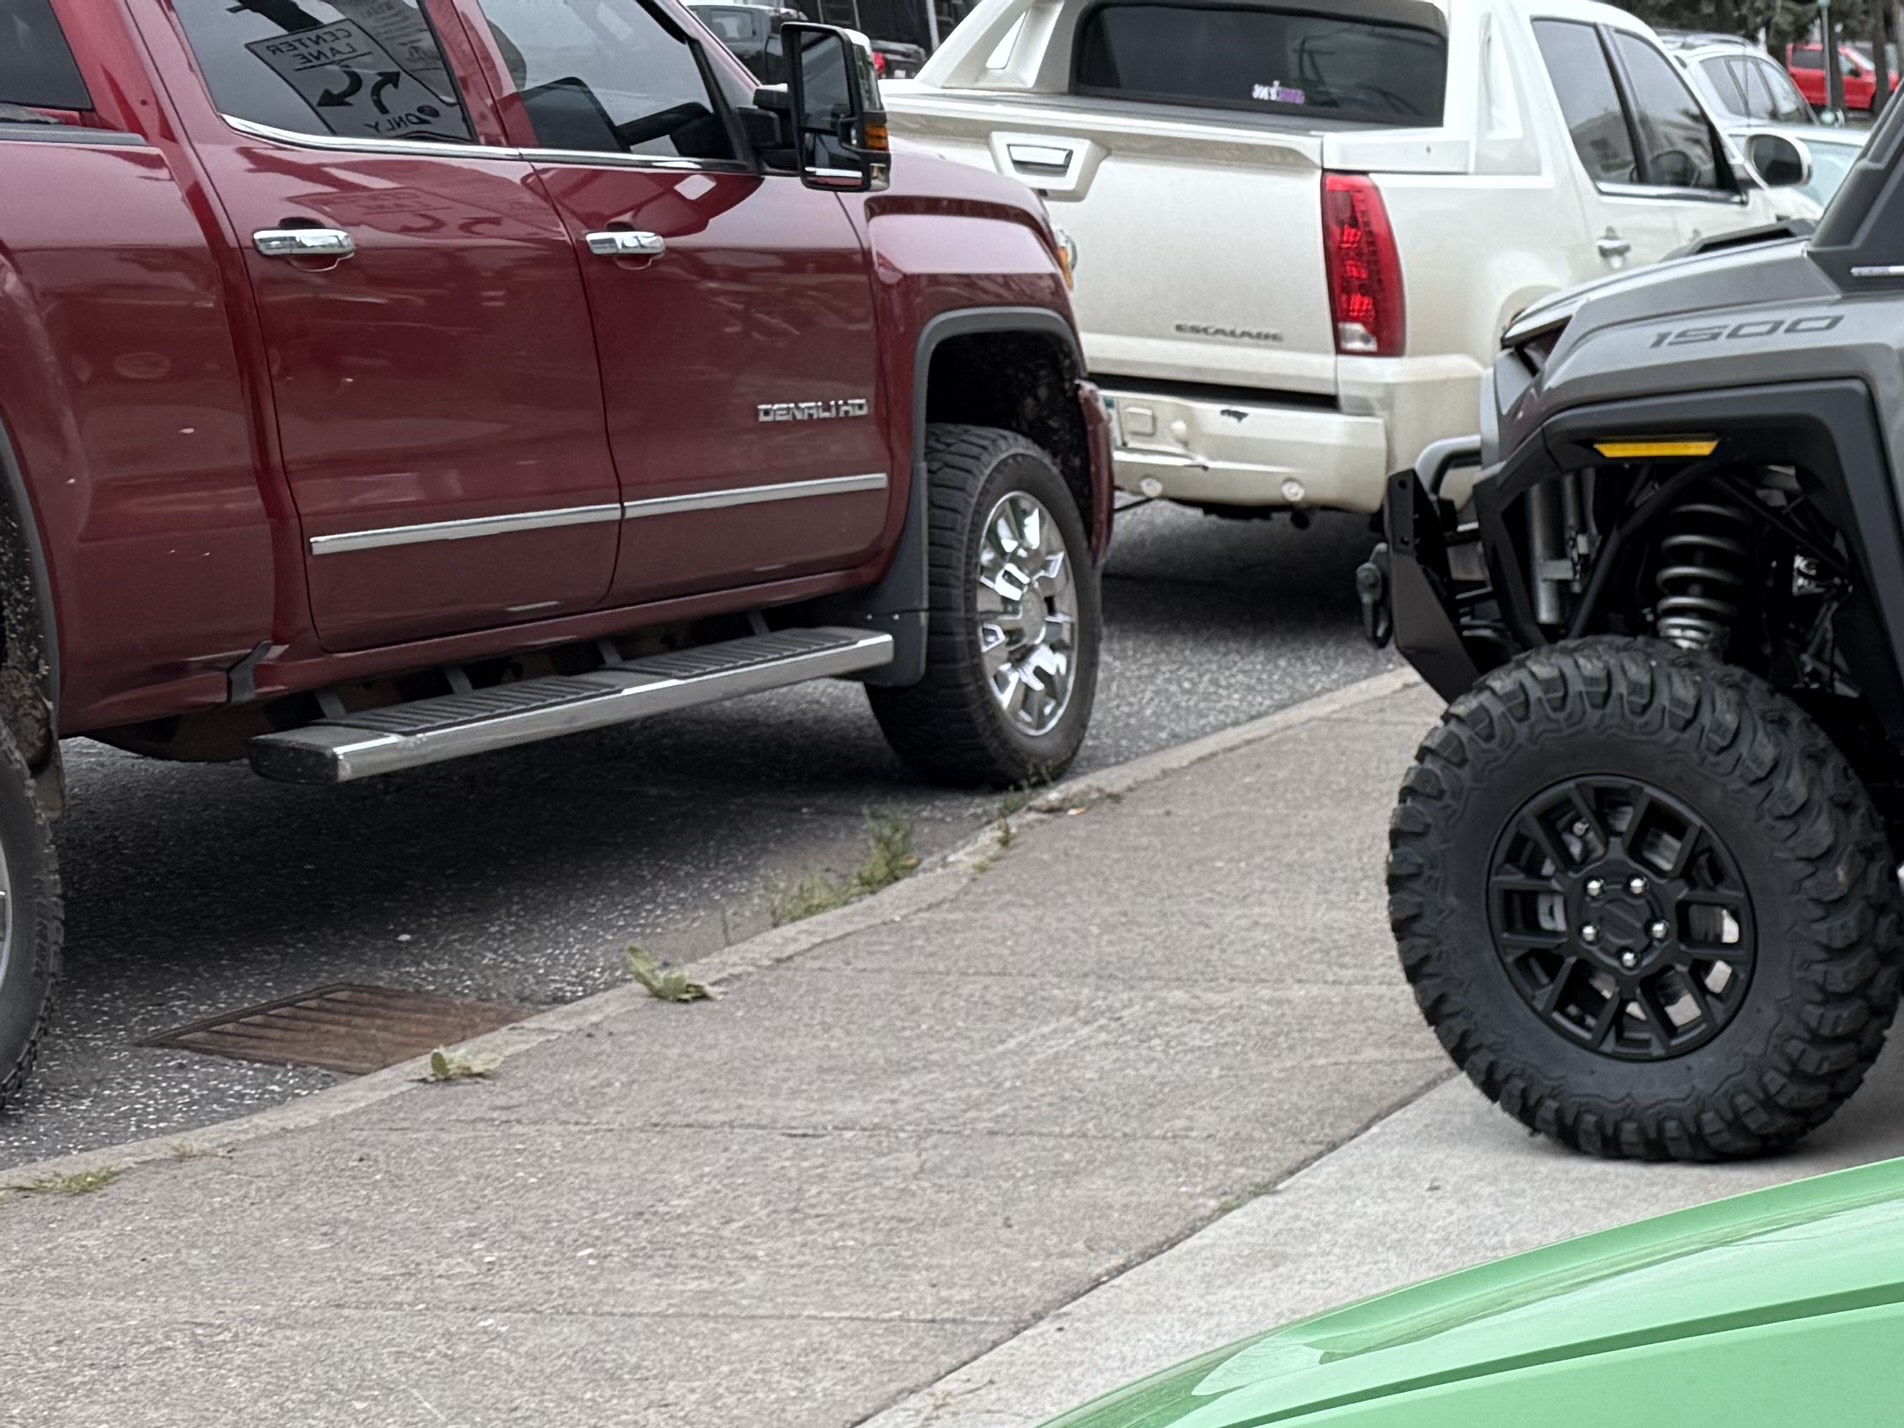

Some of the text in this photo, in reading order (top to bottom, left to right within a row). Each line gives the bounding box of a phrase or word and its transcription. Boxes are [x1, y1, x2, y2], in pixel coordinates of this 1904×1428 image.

[1650, 314, 1845, 349] 1500
[757, 398, 868, 421] DENALI HD
